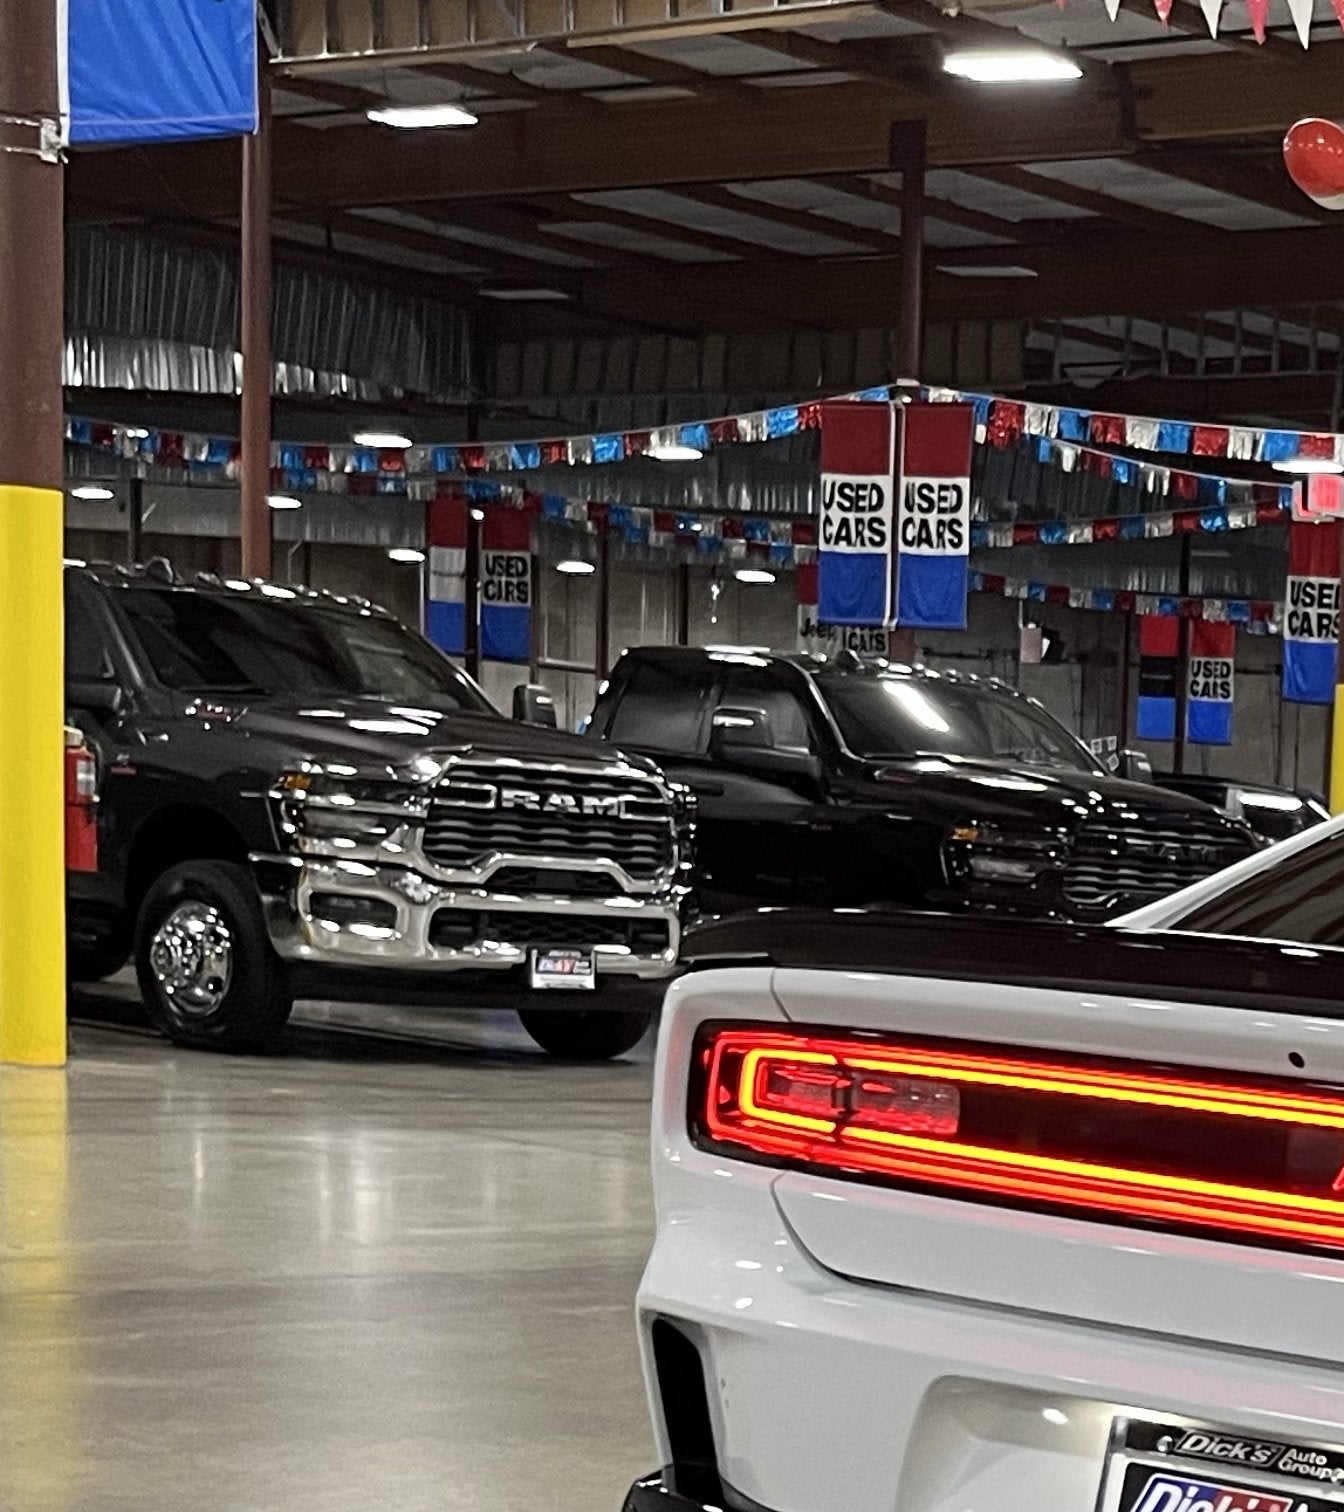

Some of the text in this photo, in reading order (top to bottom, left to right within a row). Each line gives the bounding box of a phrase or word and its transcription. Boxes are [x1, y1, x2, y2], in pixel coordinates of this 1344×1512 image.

[822, 480, 884, 512] USED
[904, 482, 963, 514] USED
[822, 515, 886, 547] CARS
[902, 517, 963, 549] CARS
[485, 555, 528, 577] USED
[1191, 660, 1231, 679] USED
[501, 789, 619, 816] RAM
[1181, 1434, 1272, 1464] Dick's
[1285, 1448, 1328, 1466] Auto
[1277, 1458, 1336, 1480] Group
